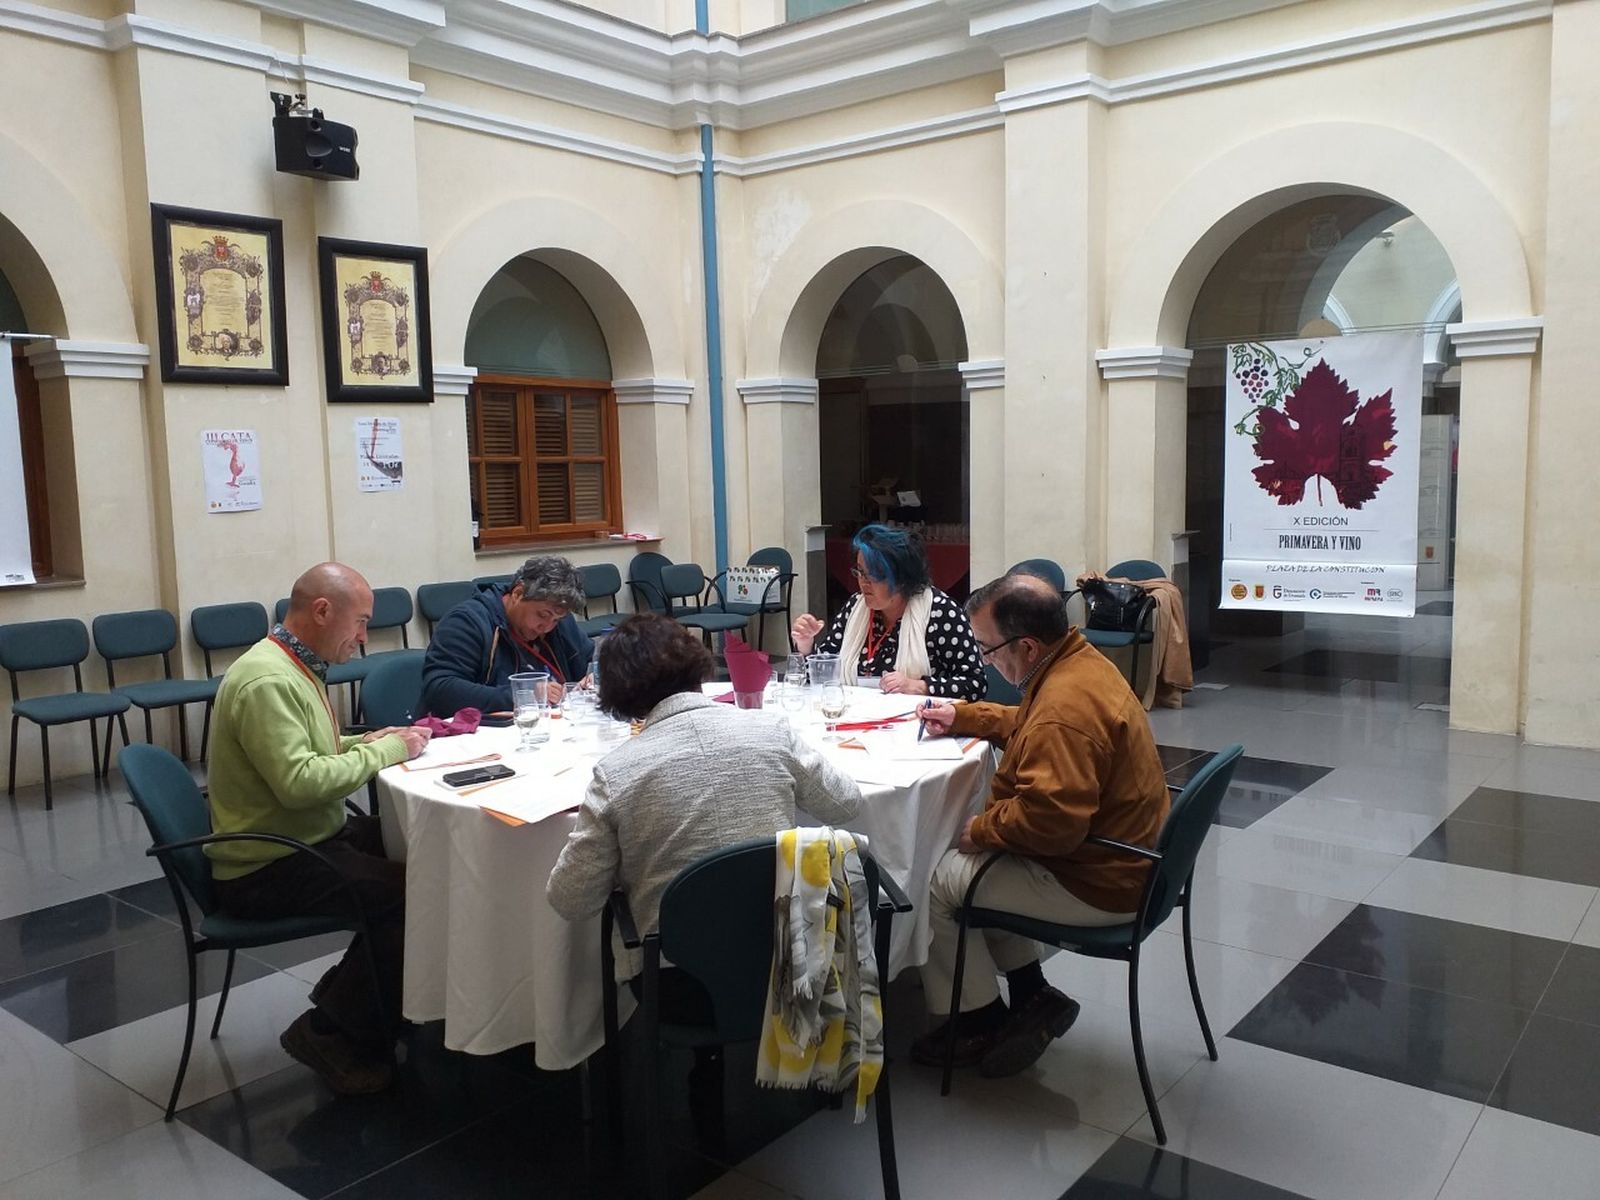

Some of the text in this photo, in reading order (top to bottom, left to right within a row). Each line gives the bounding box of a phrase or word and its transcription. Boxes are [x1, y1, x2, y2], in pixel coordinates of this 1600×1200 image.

[221, 432, 251, 440] CATA
[1293, 515, 1349, 526] X EDICIÓN
[1278, 534, 1361, 551] PRIMAVERA Y VINO
[1266, 564, 1295, 573] PLAZA
